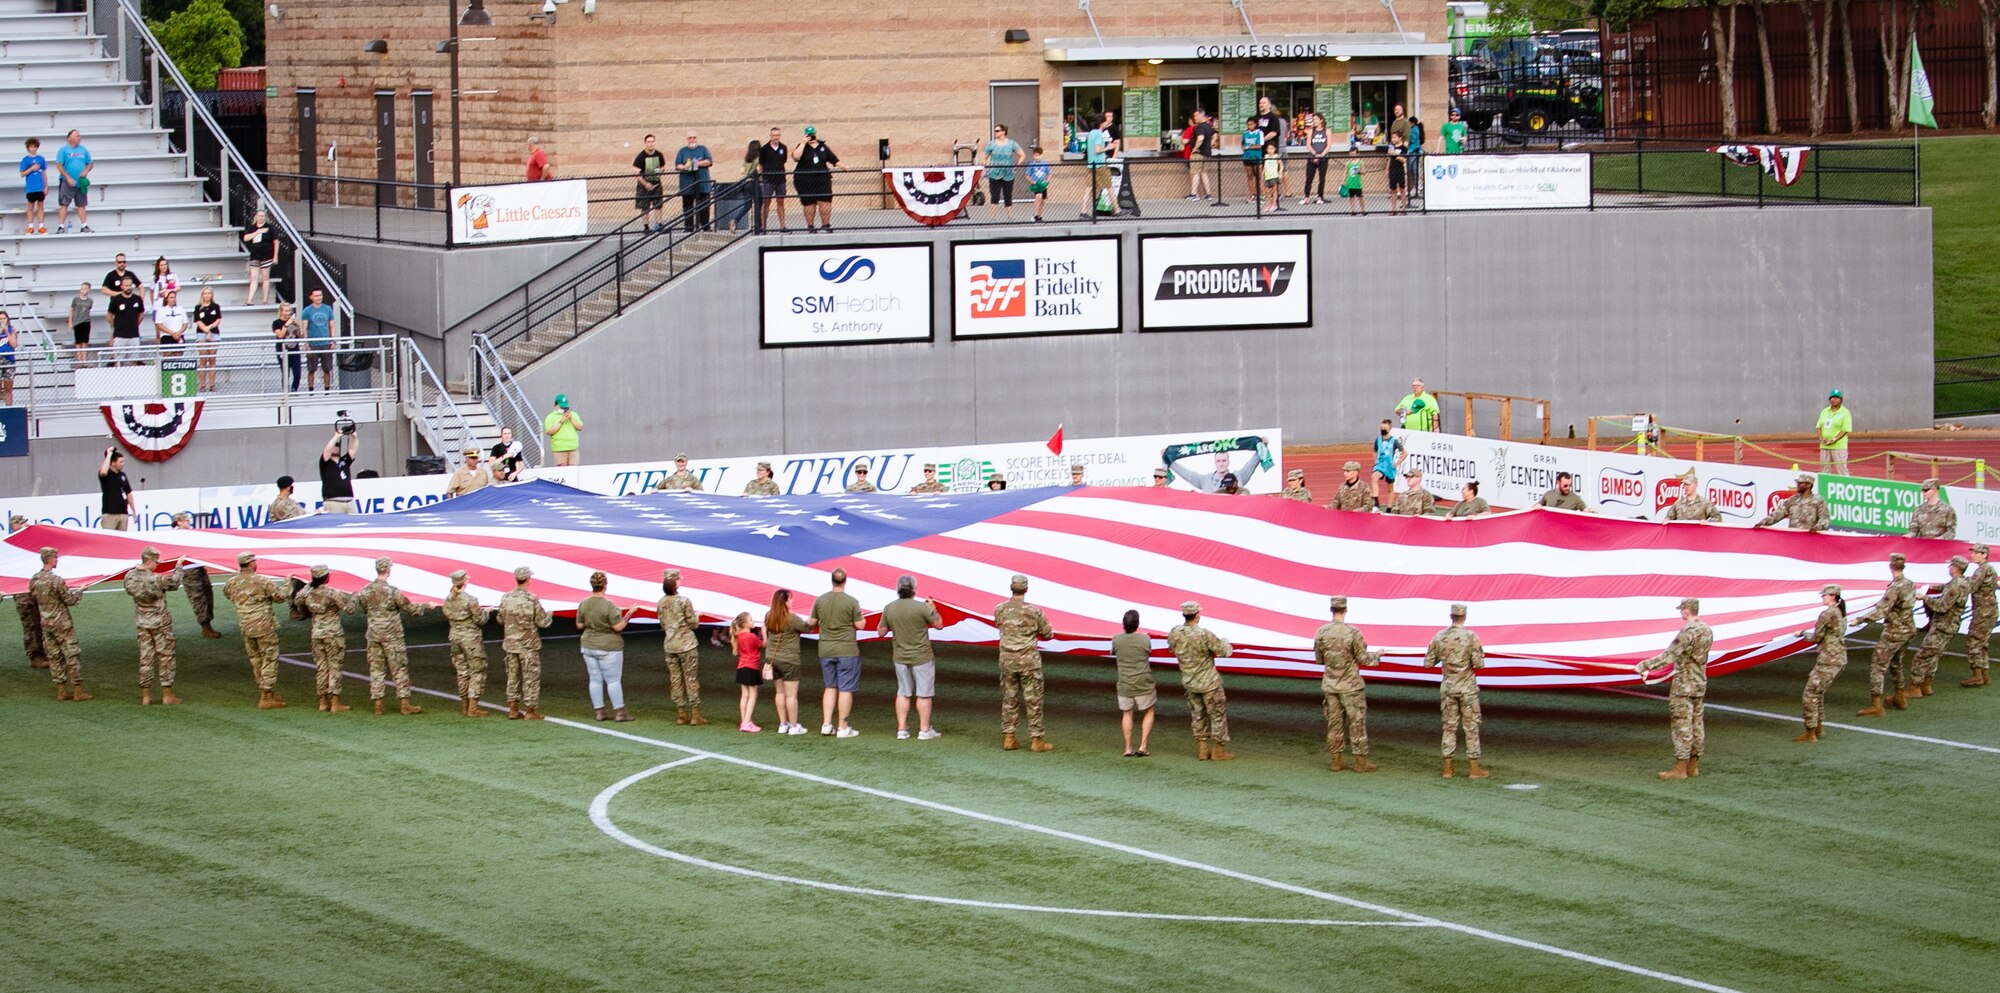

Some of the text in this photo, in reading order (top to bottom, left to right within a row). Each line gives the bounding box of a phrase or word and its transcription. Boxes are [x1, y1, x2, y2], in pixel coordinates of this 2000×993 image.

[1196, 44, 1329, 58] CONCESSIONS
[496, 205, 581, 223] Little Caesars
[1034, 258, 1078, 275] First
[1034, 277, 1103, 299] Fidelity
[1173, 268, 1263, 295] PRODIGAL
[1034, 298, 1082, 317] Bank
[812, 321, 883, 334] St. Anthony
[162, 361, 196, 370] SECTION
[170, 373, 187, 396] 8
[1431, 442, 1454, 452] GRAN
[1006, 451, 1128, 470] SCORE THE BEST DEAL
[1409, 453, 1477, 480] CENTENARIO
[1533, 454, 1558, 465] GRAN
[783, 453, 915, 495] TFCU
[1006, 470, 1024, 483] ON
[1026, 468, 1071, 482] TICKETS
[1510, 466, 1583, 493] CENTENIO
[1425, 479, 1461, 491] TEQUILA
[1601, 476, 1643, 497] BIMBO
[1708, 487, 1754, 509] BIMBO
[1827, 482, 1925, 508] PROTECT YOU
[1828, 503, 1882, 526] UNIQUE
[1964, 499, 2000, 517] Indivi
